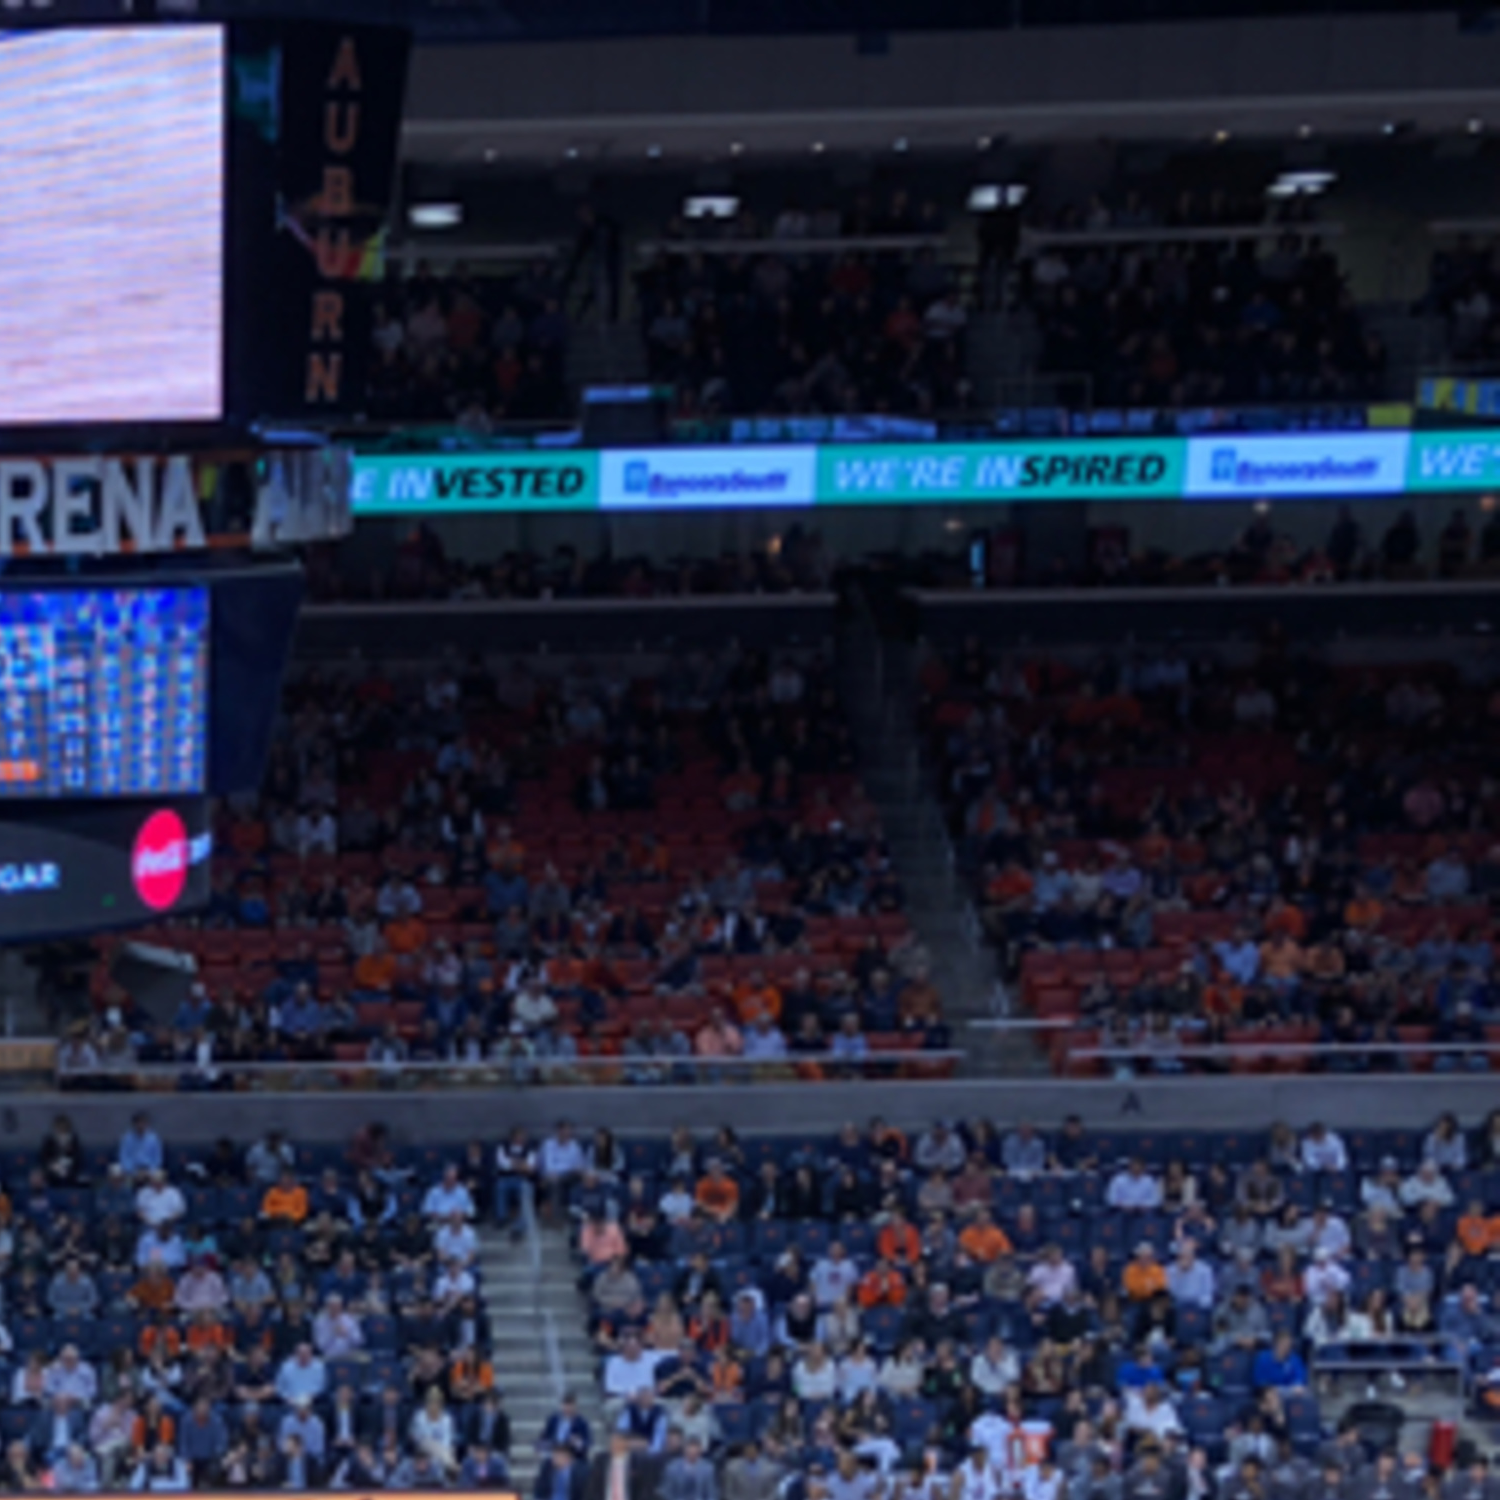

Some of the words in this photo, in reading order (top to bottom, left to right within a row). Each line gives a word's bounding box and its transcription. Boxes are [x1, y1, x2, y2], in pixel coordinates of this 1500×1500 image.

[302, 34, 363, 403] AUBURN
[388, 464, 585, 500] INVESTED
[834, 455, 967, 491] WE'RE
[975, 451, 1167, 488] INSPIRED
